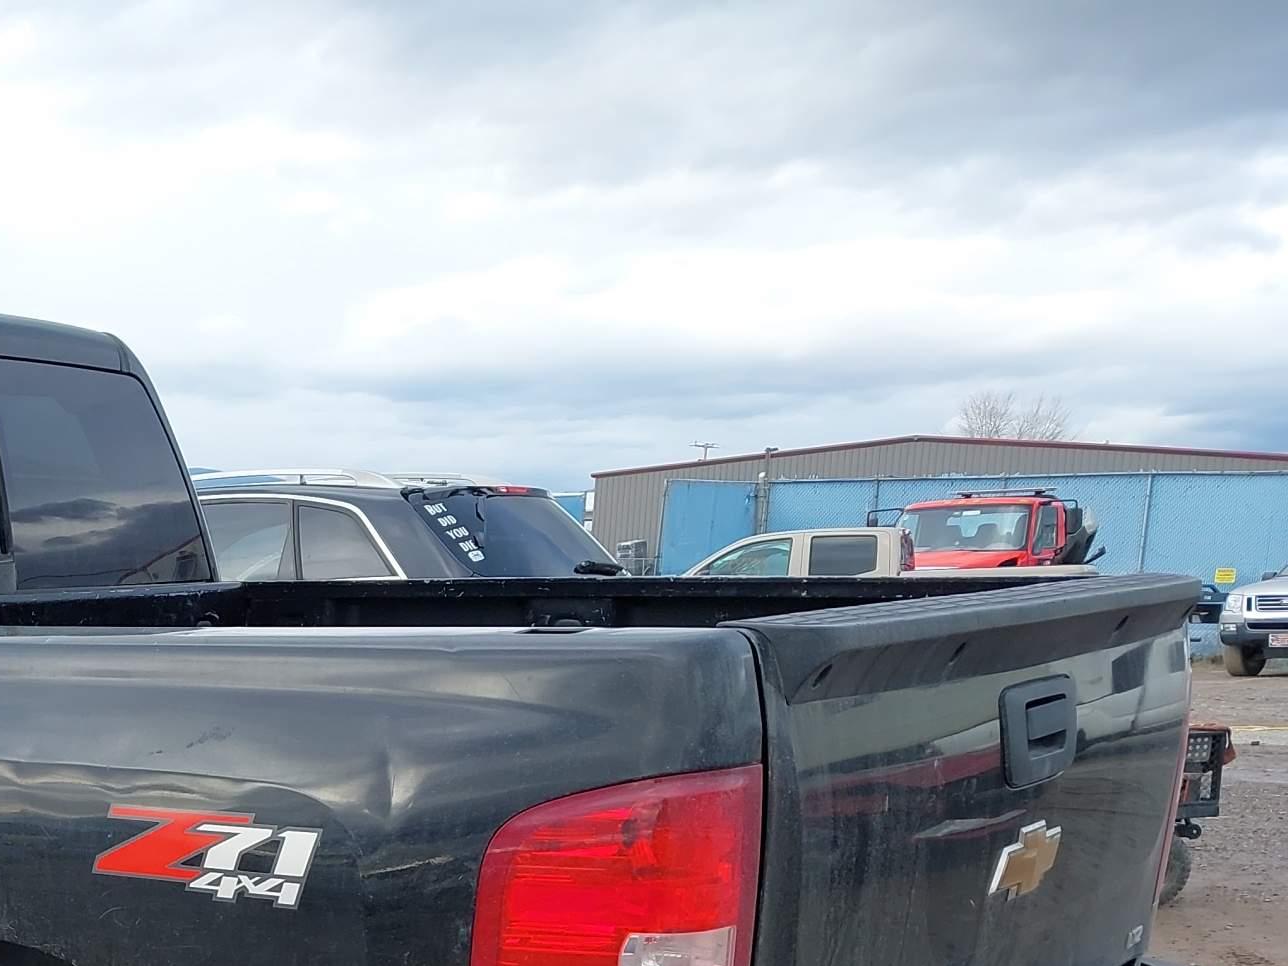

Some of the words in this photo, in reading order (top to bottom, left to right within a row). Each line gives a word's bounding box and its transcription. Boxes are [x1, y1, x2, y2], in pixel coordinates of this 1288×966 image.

[424, 502, 447, 516] BUT
[437, 514, 457, 527] DID
[445, 526, 469, 540] YOU
[458, 539, 479, 552] DIE
[92, 803, 323, 884] Z71
